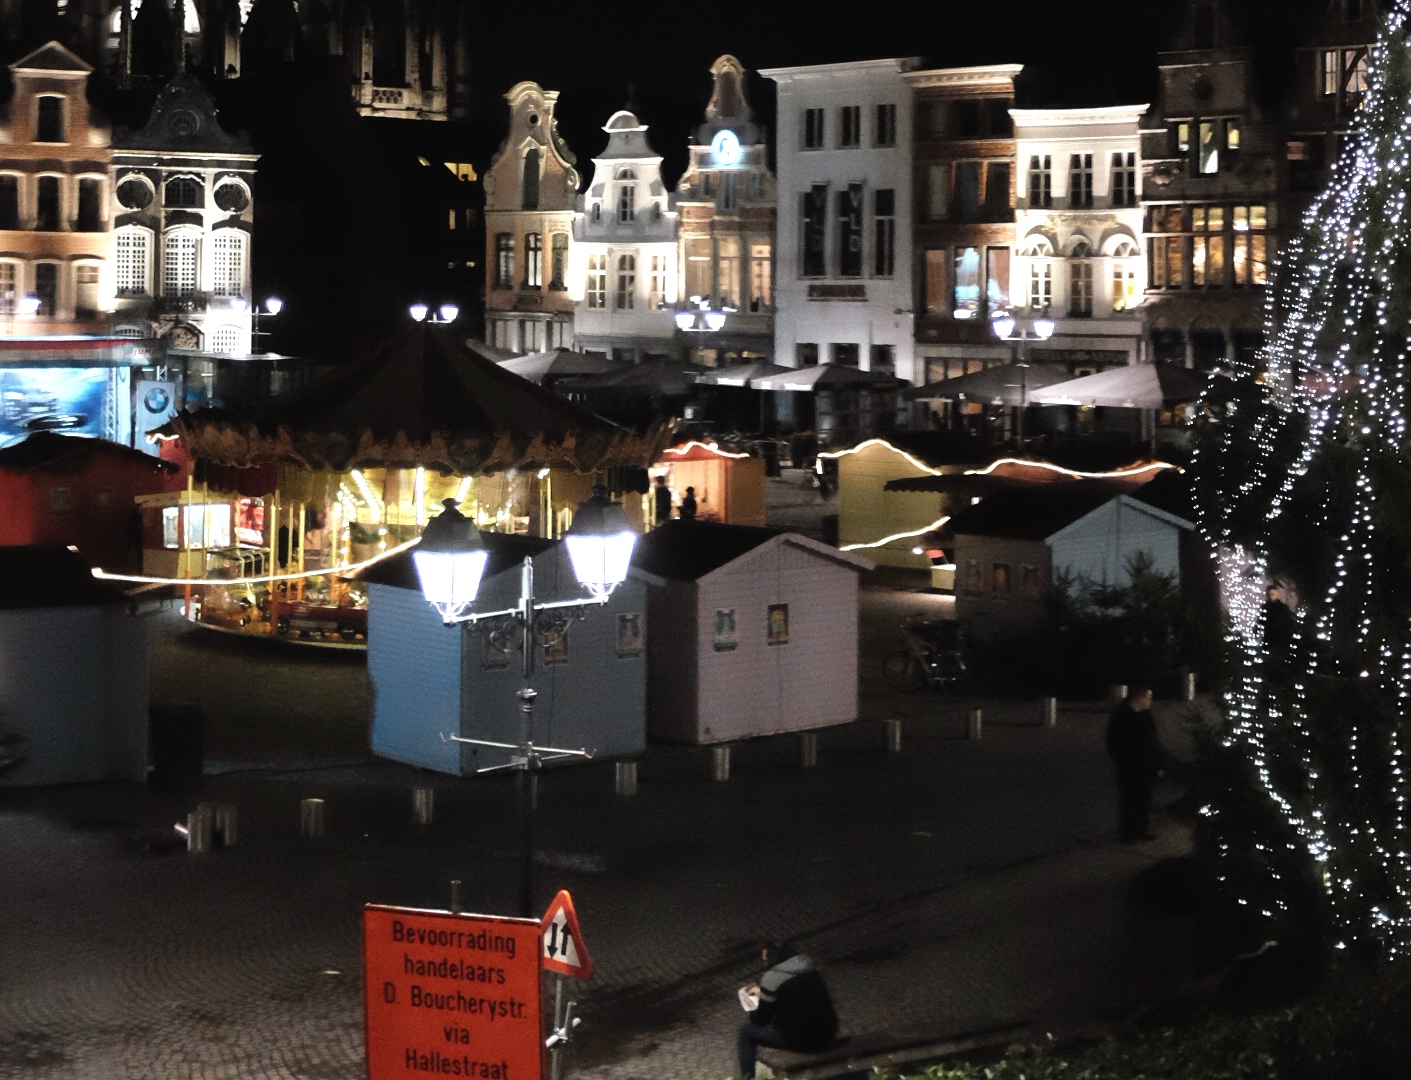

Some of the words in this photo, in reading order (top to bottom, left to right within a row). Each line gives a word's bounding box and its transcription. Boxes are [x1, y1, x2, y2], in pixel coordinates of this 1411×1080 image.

[392, 921, 516, 959] Bevoorrading
[403, 954, 506, 985] handelaars
[411, 985, 527, 1022] Boucherystr.
[443, 1023, 470, 1044] via
[406, 1049, 509, 1080] Hallestraat
